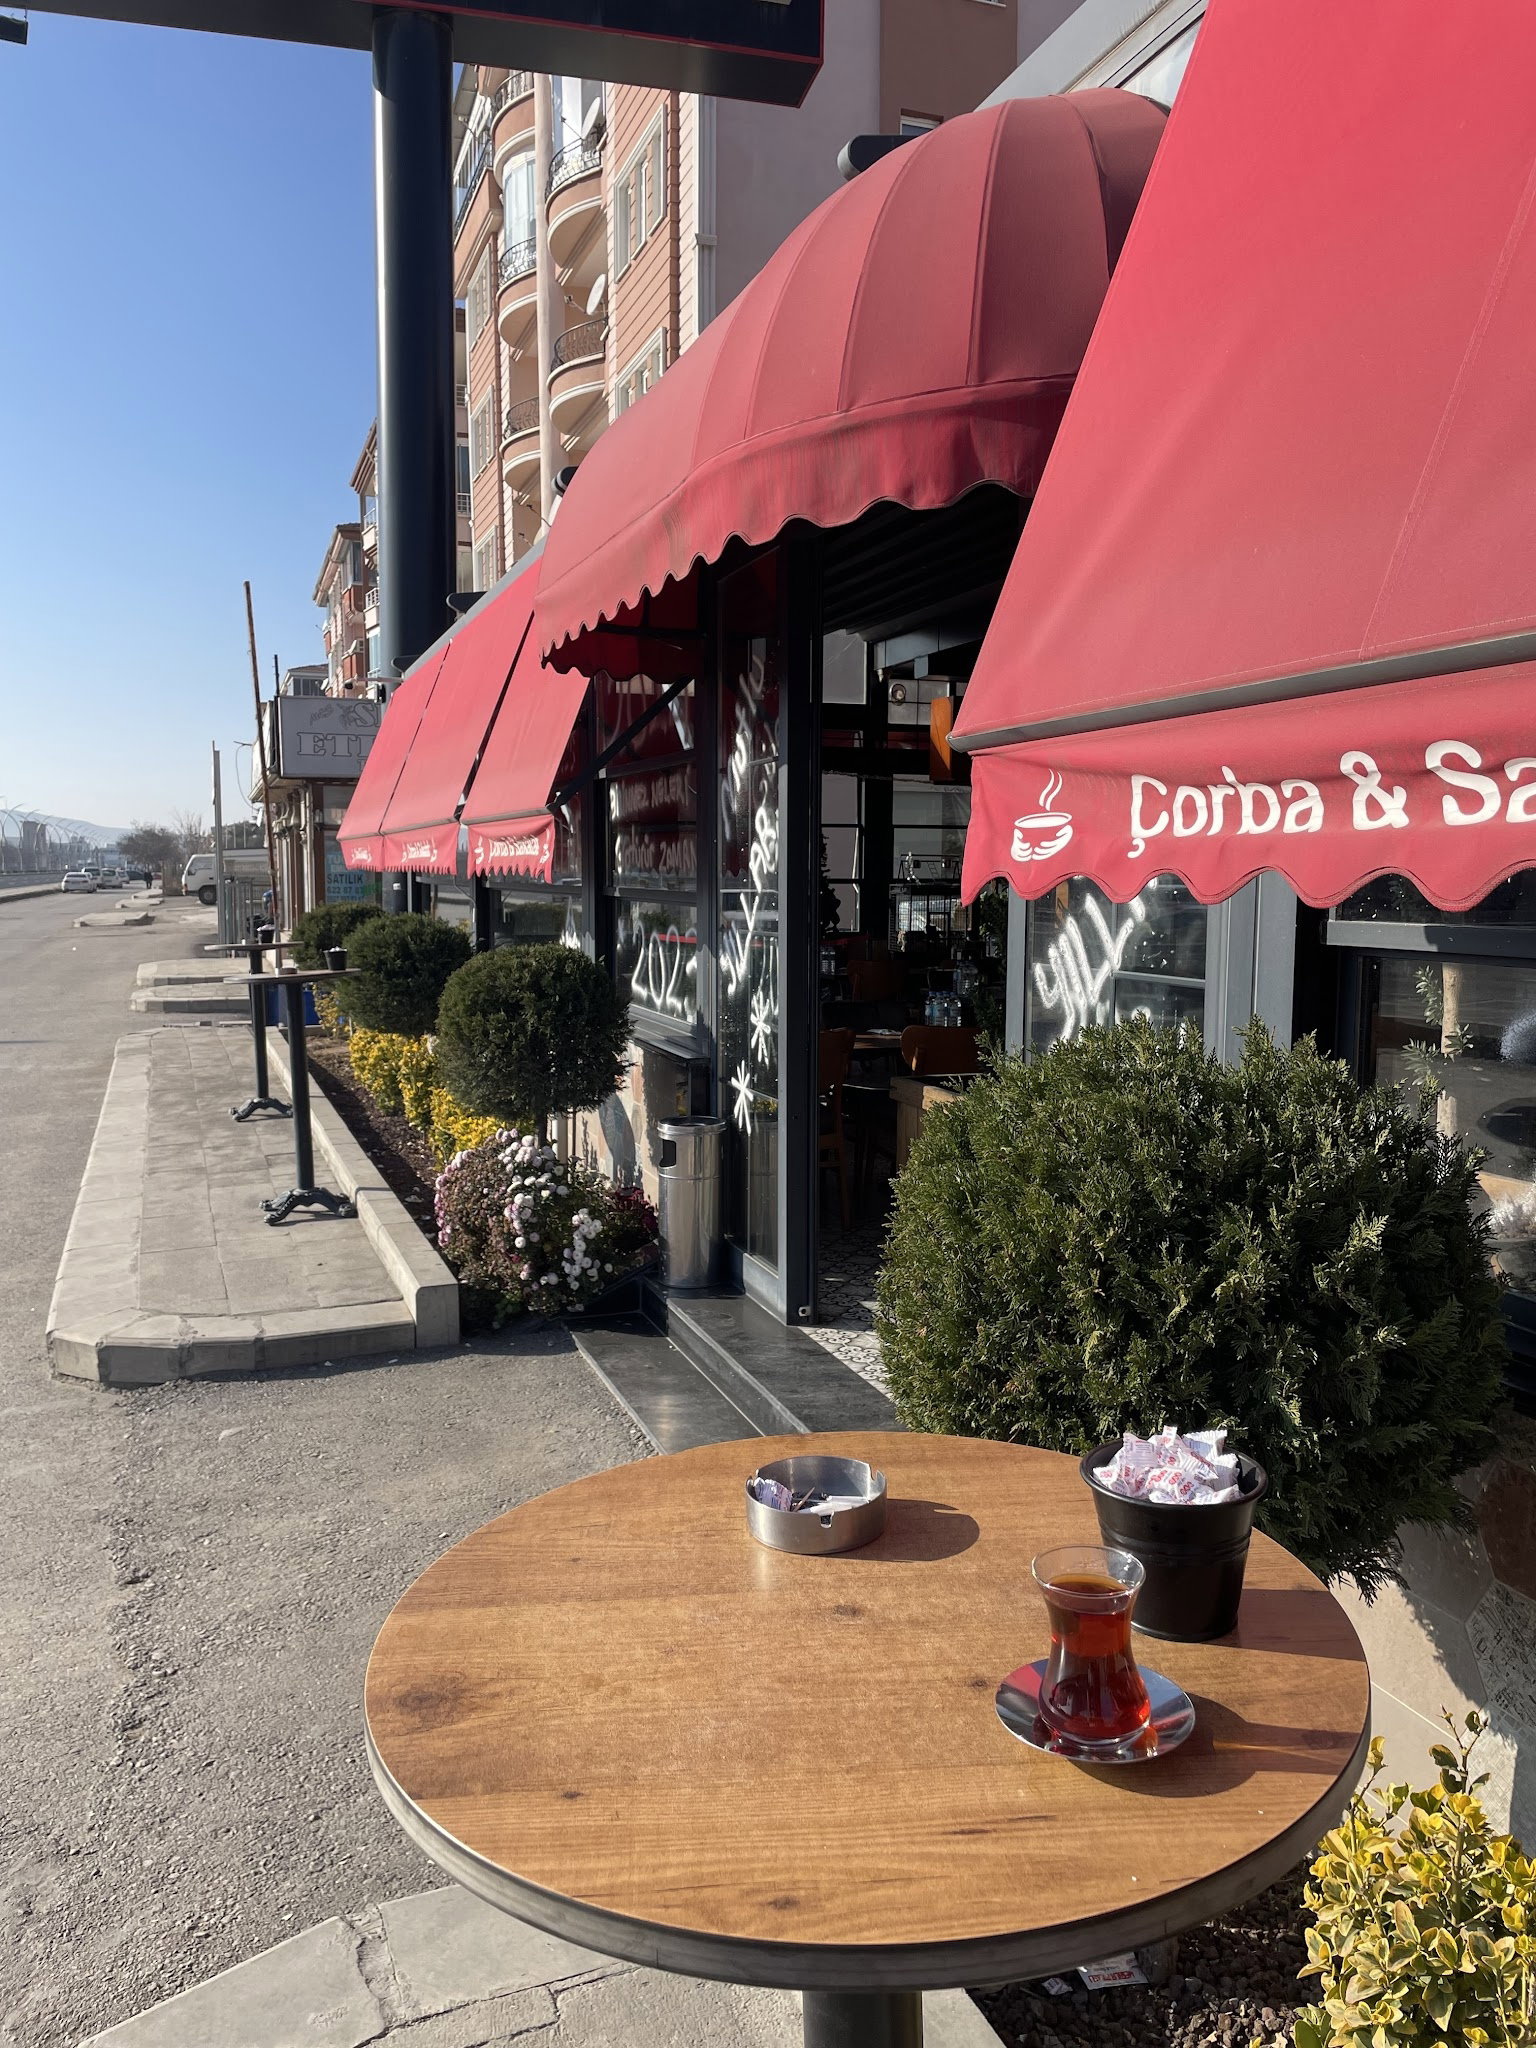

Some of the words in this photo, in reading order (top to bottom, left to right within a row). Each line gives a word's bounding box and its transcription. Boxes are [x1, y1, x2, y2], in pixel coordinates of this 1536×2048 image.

[1126, 765, 1325, 859] Çorba
[1339, 750, 1409, 831] &
[327, 873, 363, 885] SATILIK
